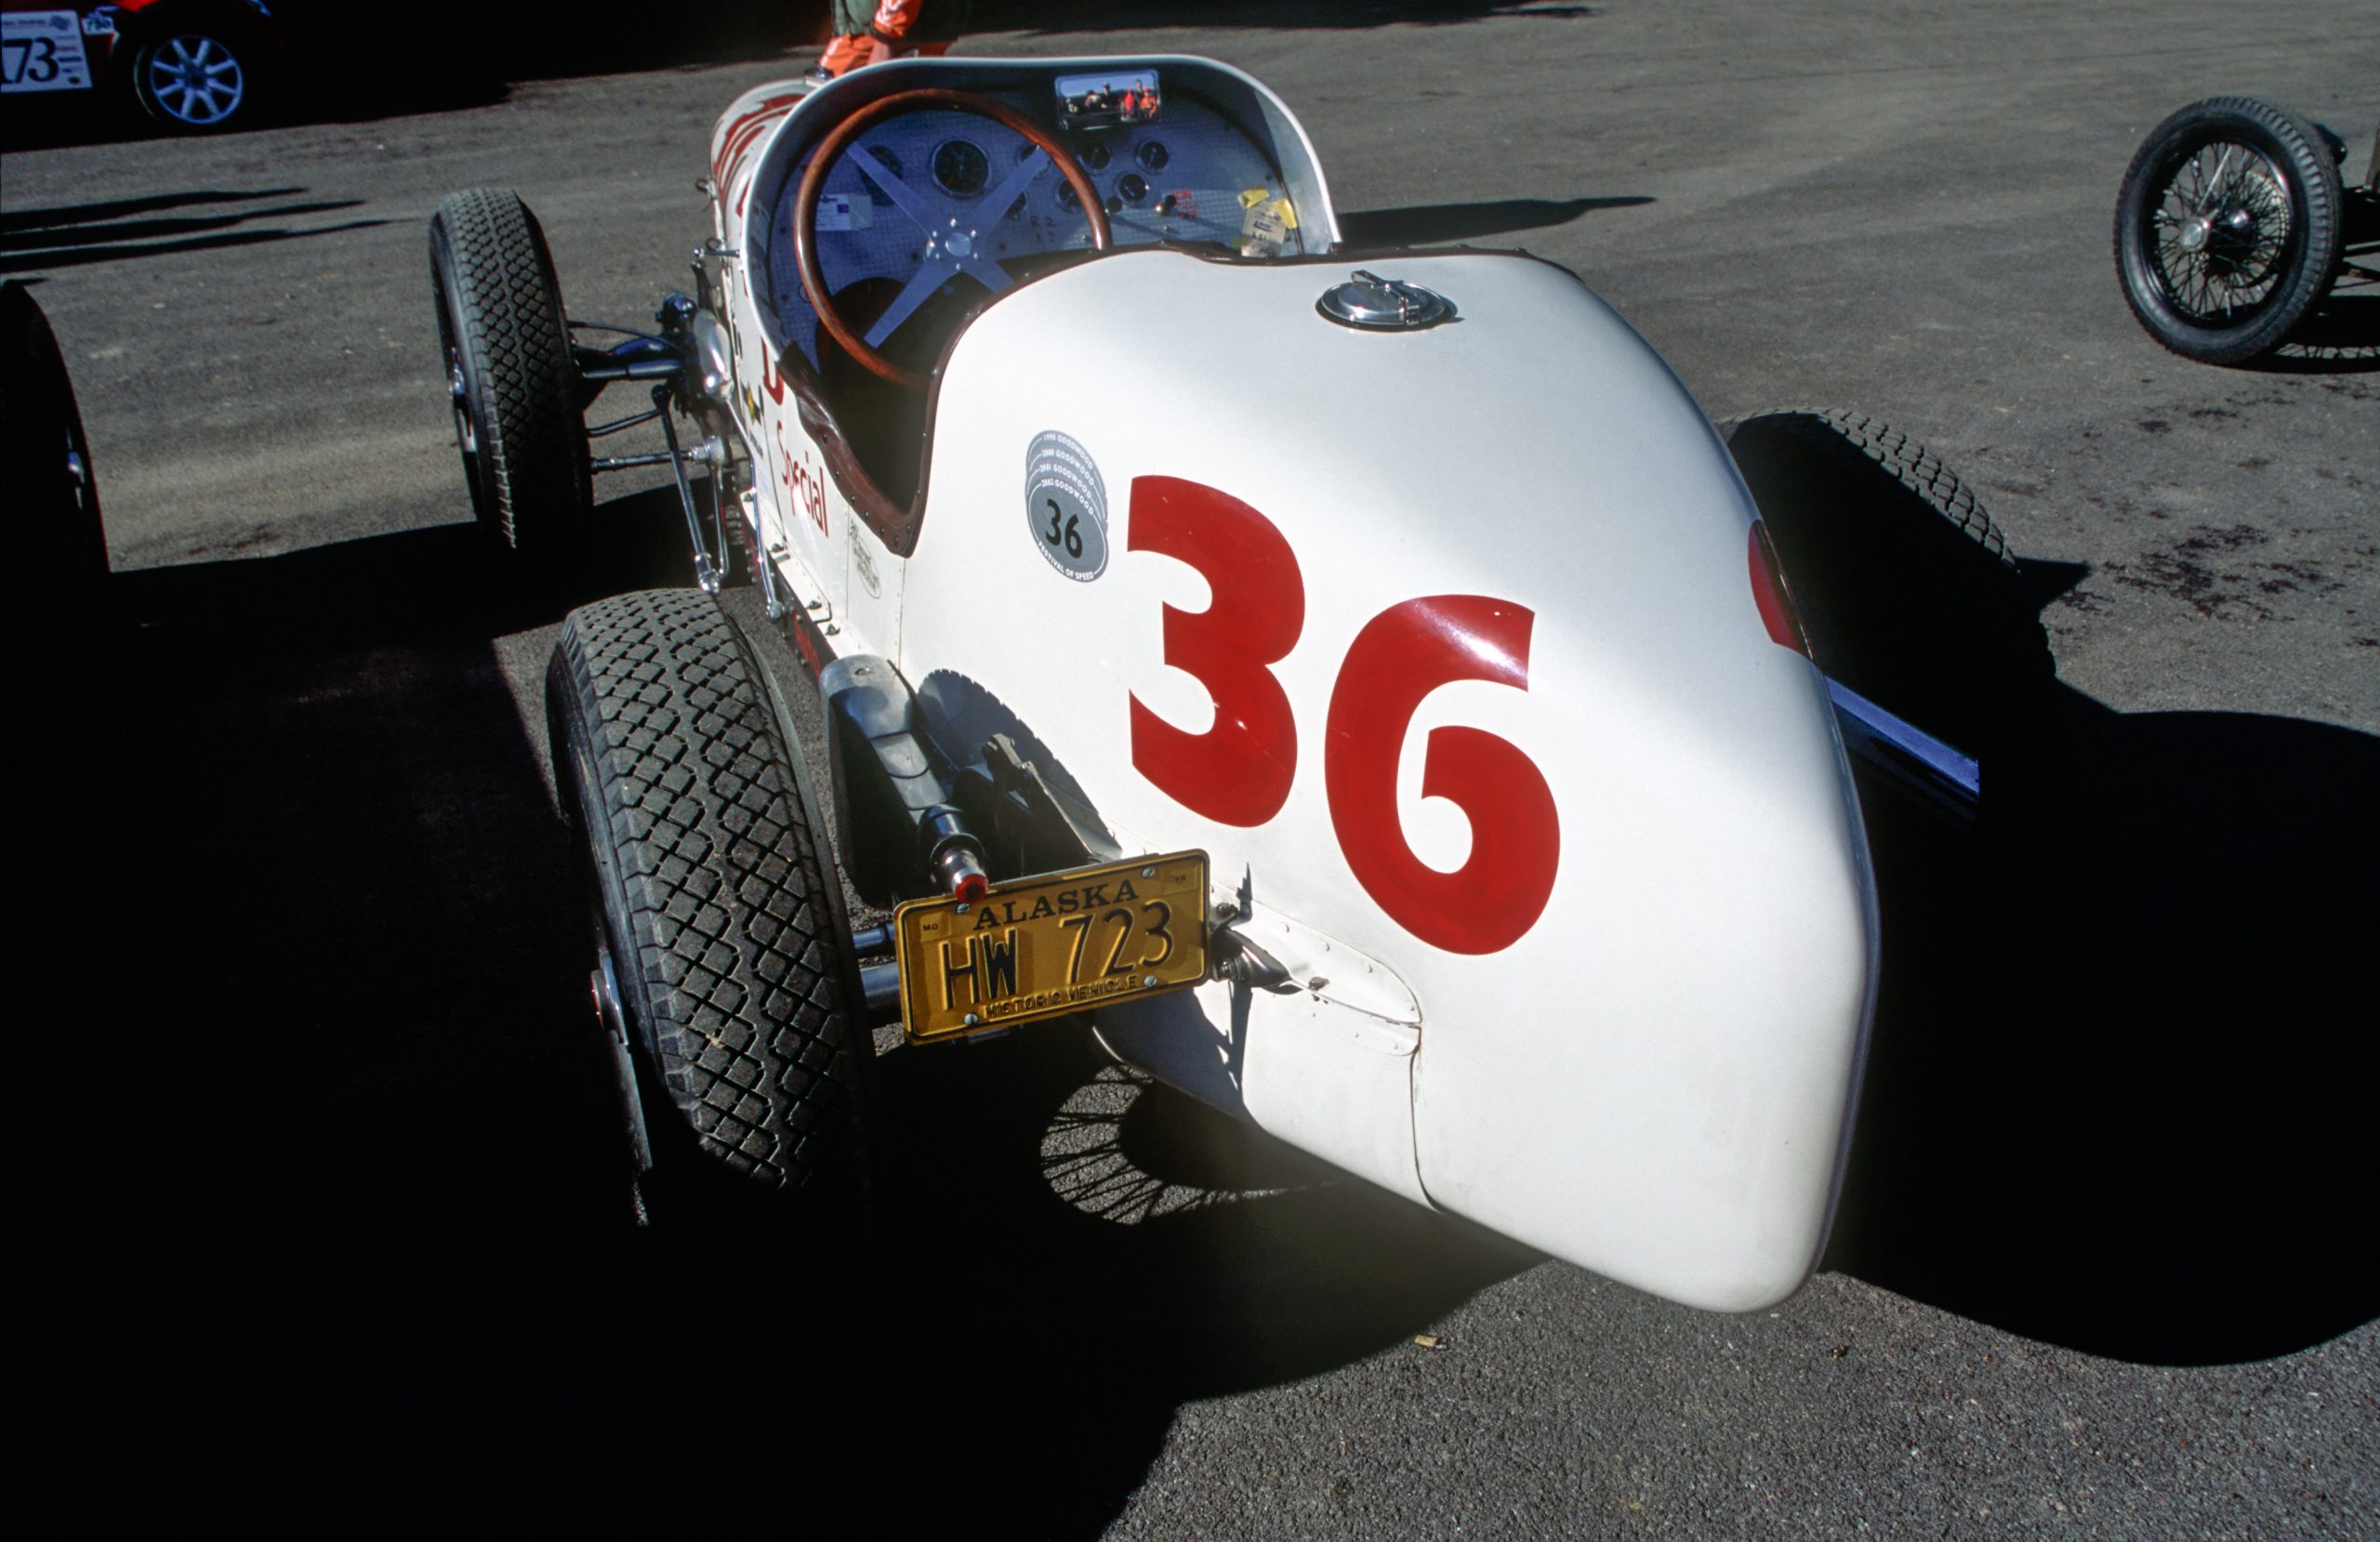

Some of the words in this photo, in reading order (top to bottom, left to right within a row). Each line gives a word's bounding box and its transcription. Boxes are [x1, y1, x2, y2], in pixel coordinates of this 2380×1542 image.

[1, 37, 59, 83] 73
[1055, 449, 1094, 486] GOODWOOD
[1057, 434, 1093, 470] GOODWOOD
[1052, 464, 1092, 499] GOODWOOD
[1054, 479, 1094, 516] GOODWOOD
[1045, 497, 1083, 560] 36
[1038, 540, 1064, 573] FESTIVAL
[1065, 568, 1074, 577] OF
[1075, 572, 1094, 581] SPEED
[1127, 475, 1561, 956] 36
[972, 878, 1139, 930] ALASKA
[922, 923, 939, 931] MO
[940, 927, 1018, 1011] HW
[1058, 898, 1175, 984] 723
[983, 989, 1064, 1019] HISTORIC
[1066, 974, 1139, 1002] VEHICLE
